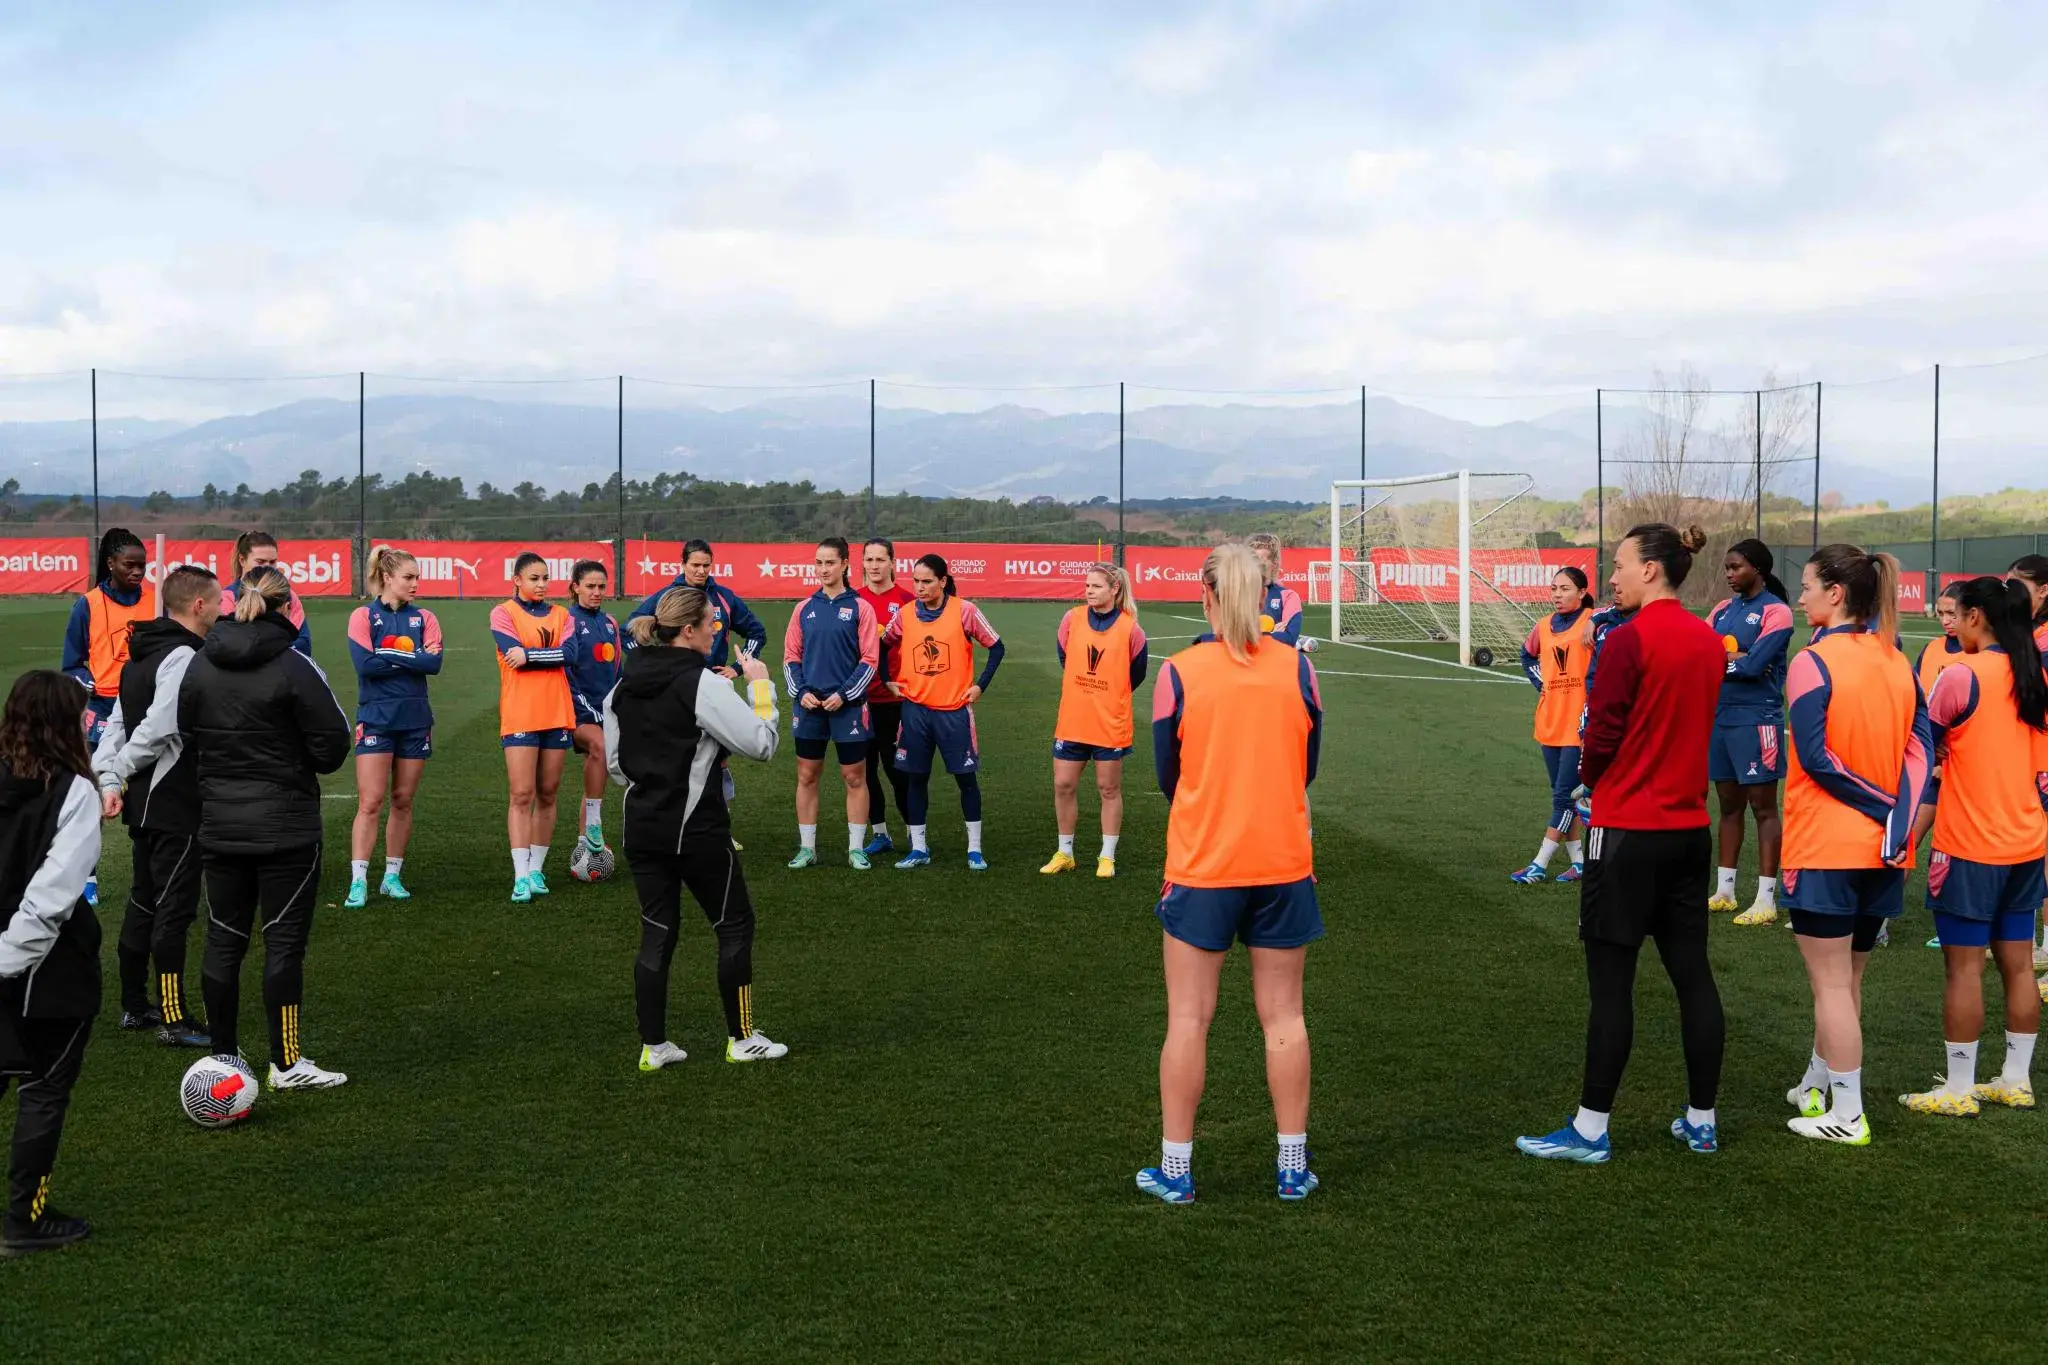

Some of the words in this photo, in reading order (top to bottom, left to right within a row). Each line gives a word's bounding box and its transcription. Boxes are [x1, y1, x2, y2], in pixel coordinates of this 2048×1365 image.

[504, 558, 574, 581] PMA
[950, 559, 987, 567] CUIDADO
[1163, 567, 1204, 581] Caixa
[1380, 563, 1446, 586] PUMA
